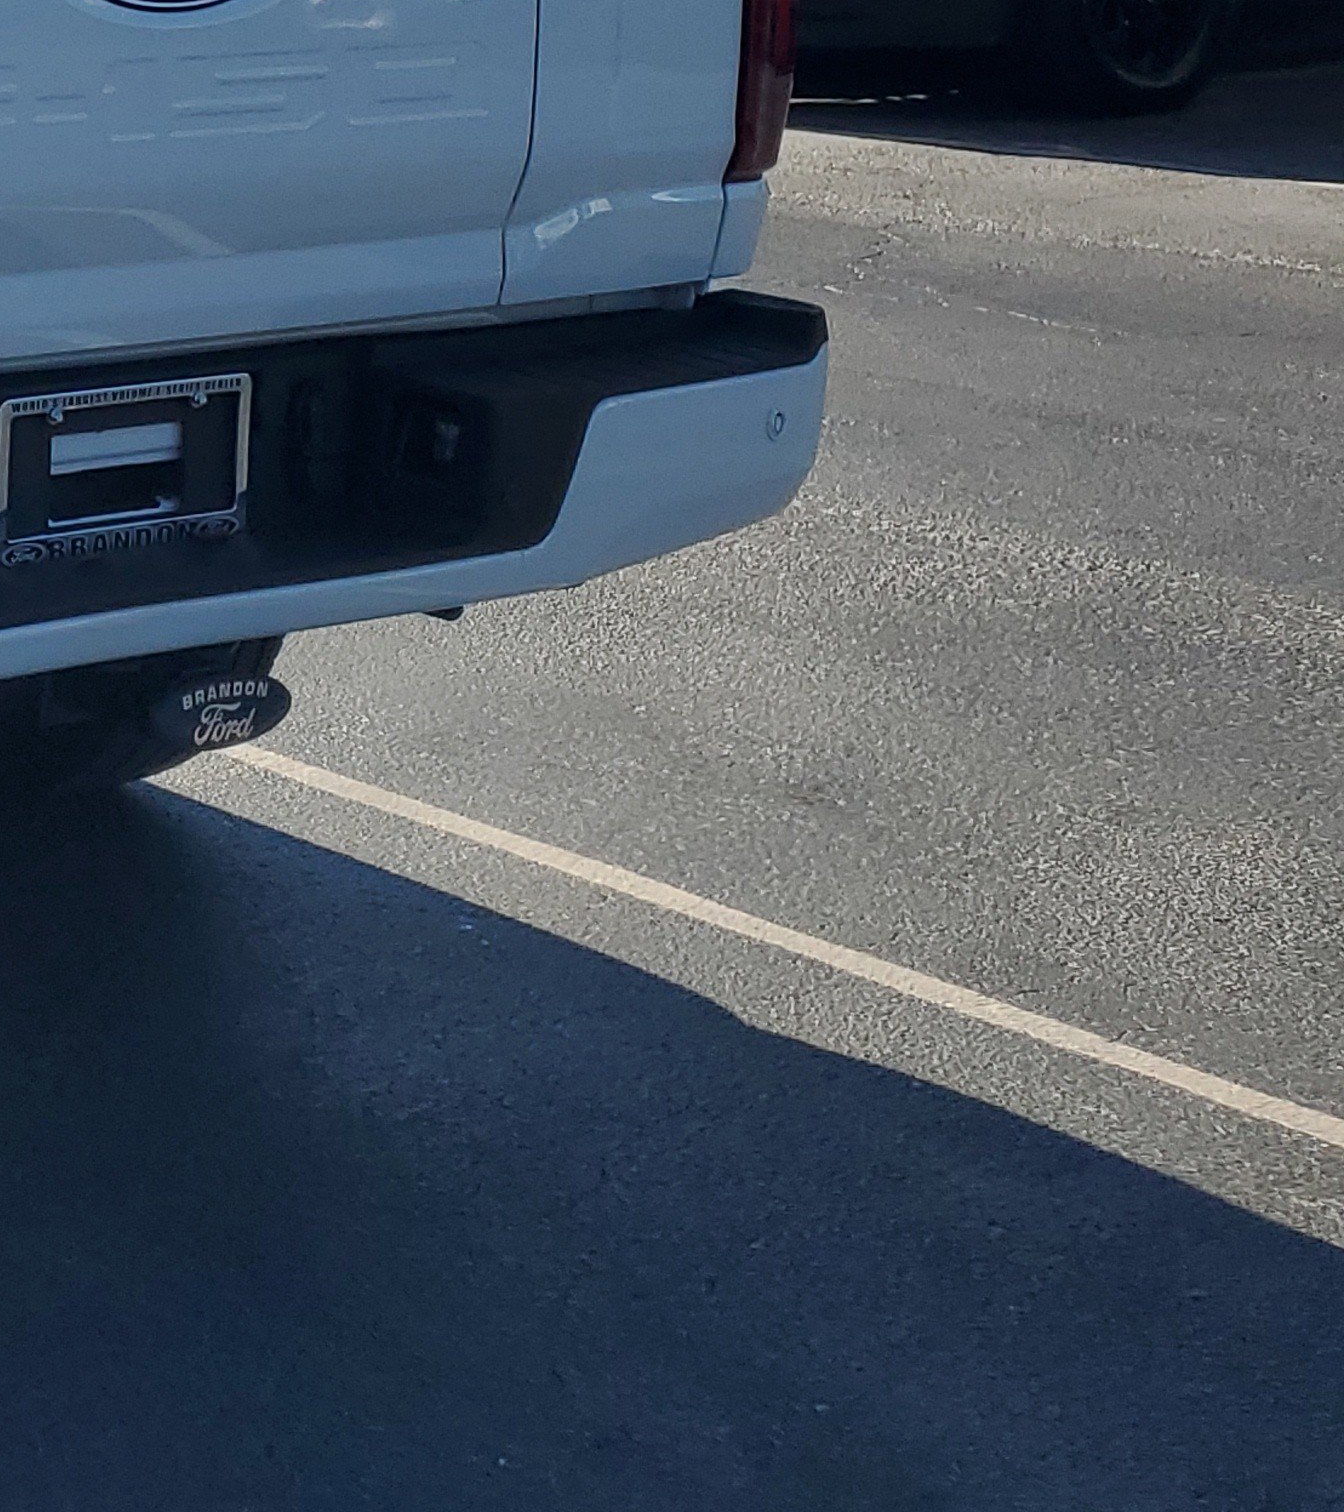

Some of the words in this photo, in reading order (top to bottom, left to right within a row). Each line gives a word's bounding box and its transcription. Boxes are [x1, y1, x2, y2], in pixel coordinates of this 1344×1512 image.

[48, 522, 193, 559] BRANDON
[182, 681, 269, 711] BRANDON
[194, 701, 256, 746] Ford
